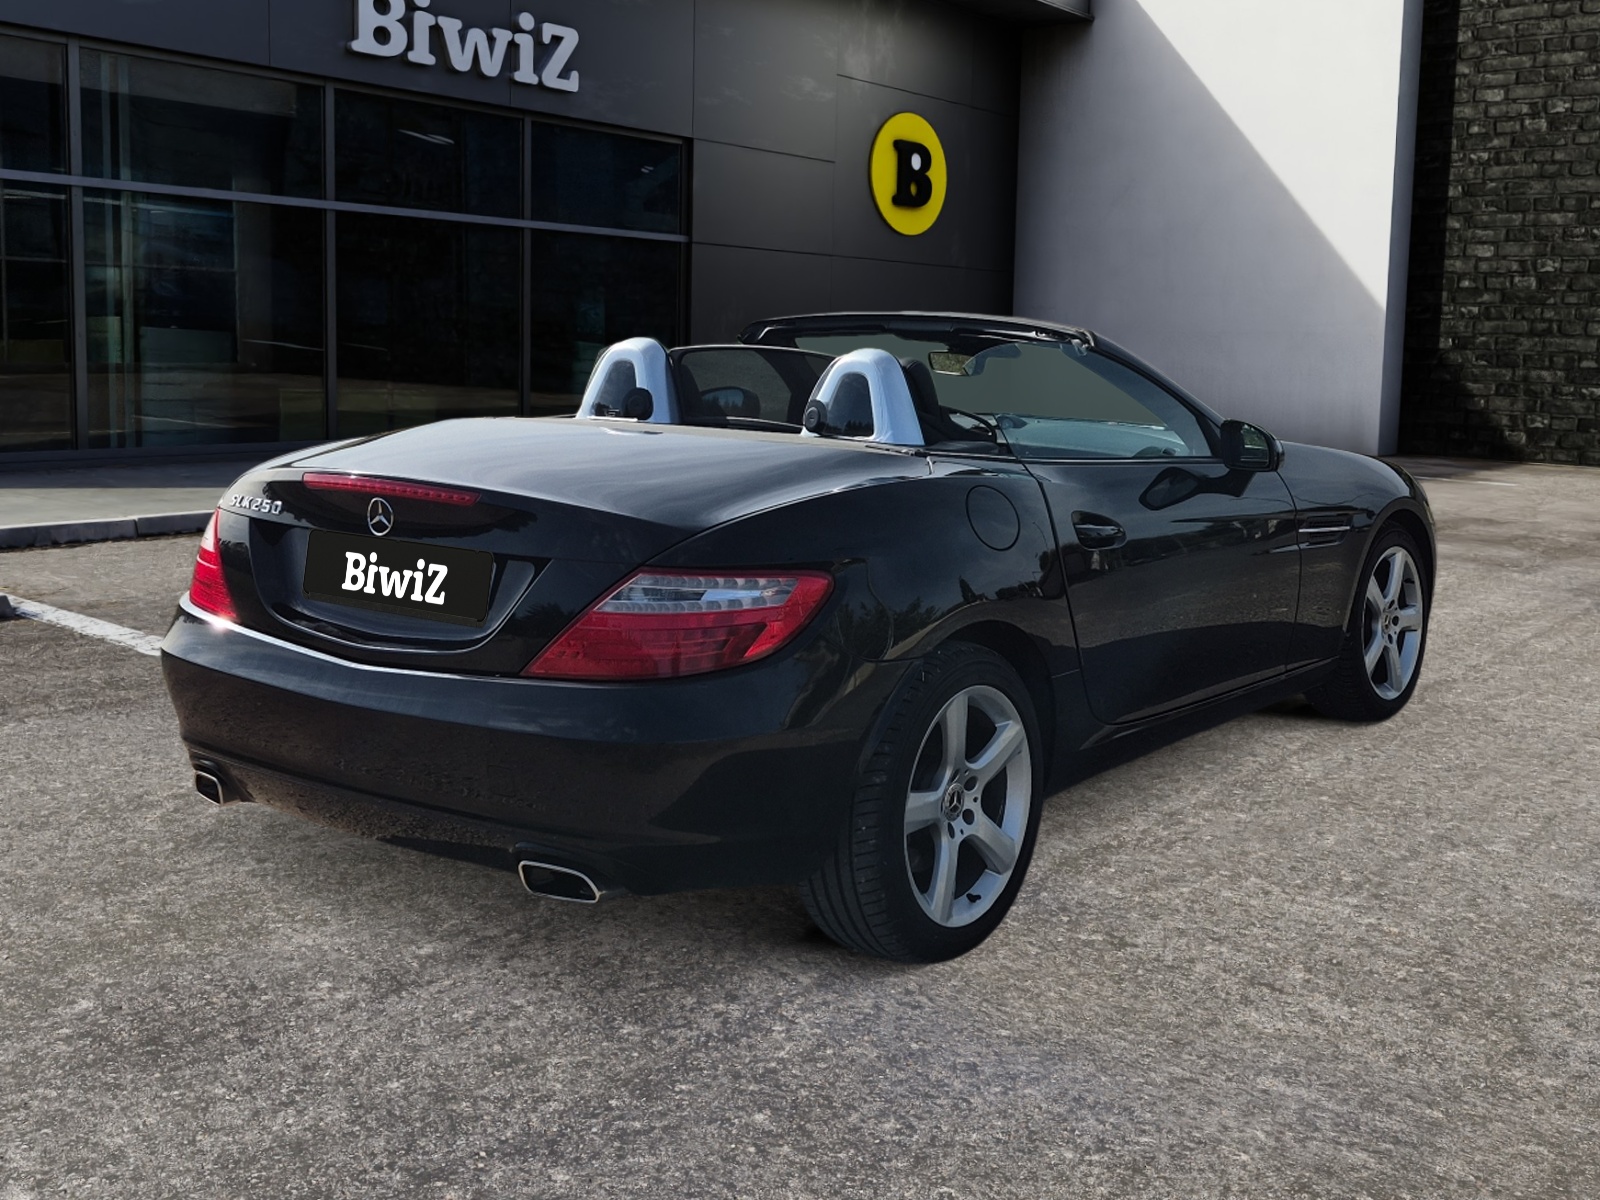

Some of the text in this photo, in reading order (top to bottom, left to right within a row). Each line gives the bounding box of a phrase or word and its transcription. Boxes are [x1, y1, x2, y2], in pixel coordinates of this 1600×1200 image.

[350, 0, 579, 92] BiwiZ
[892, 139, 932, 207] B
[341, 551, 448, 605] BiwiZ
